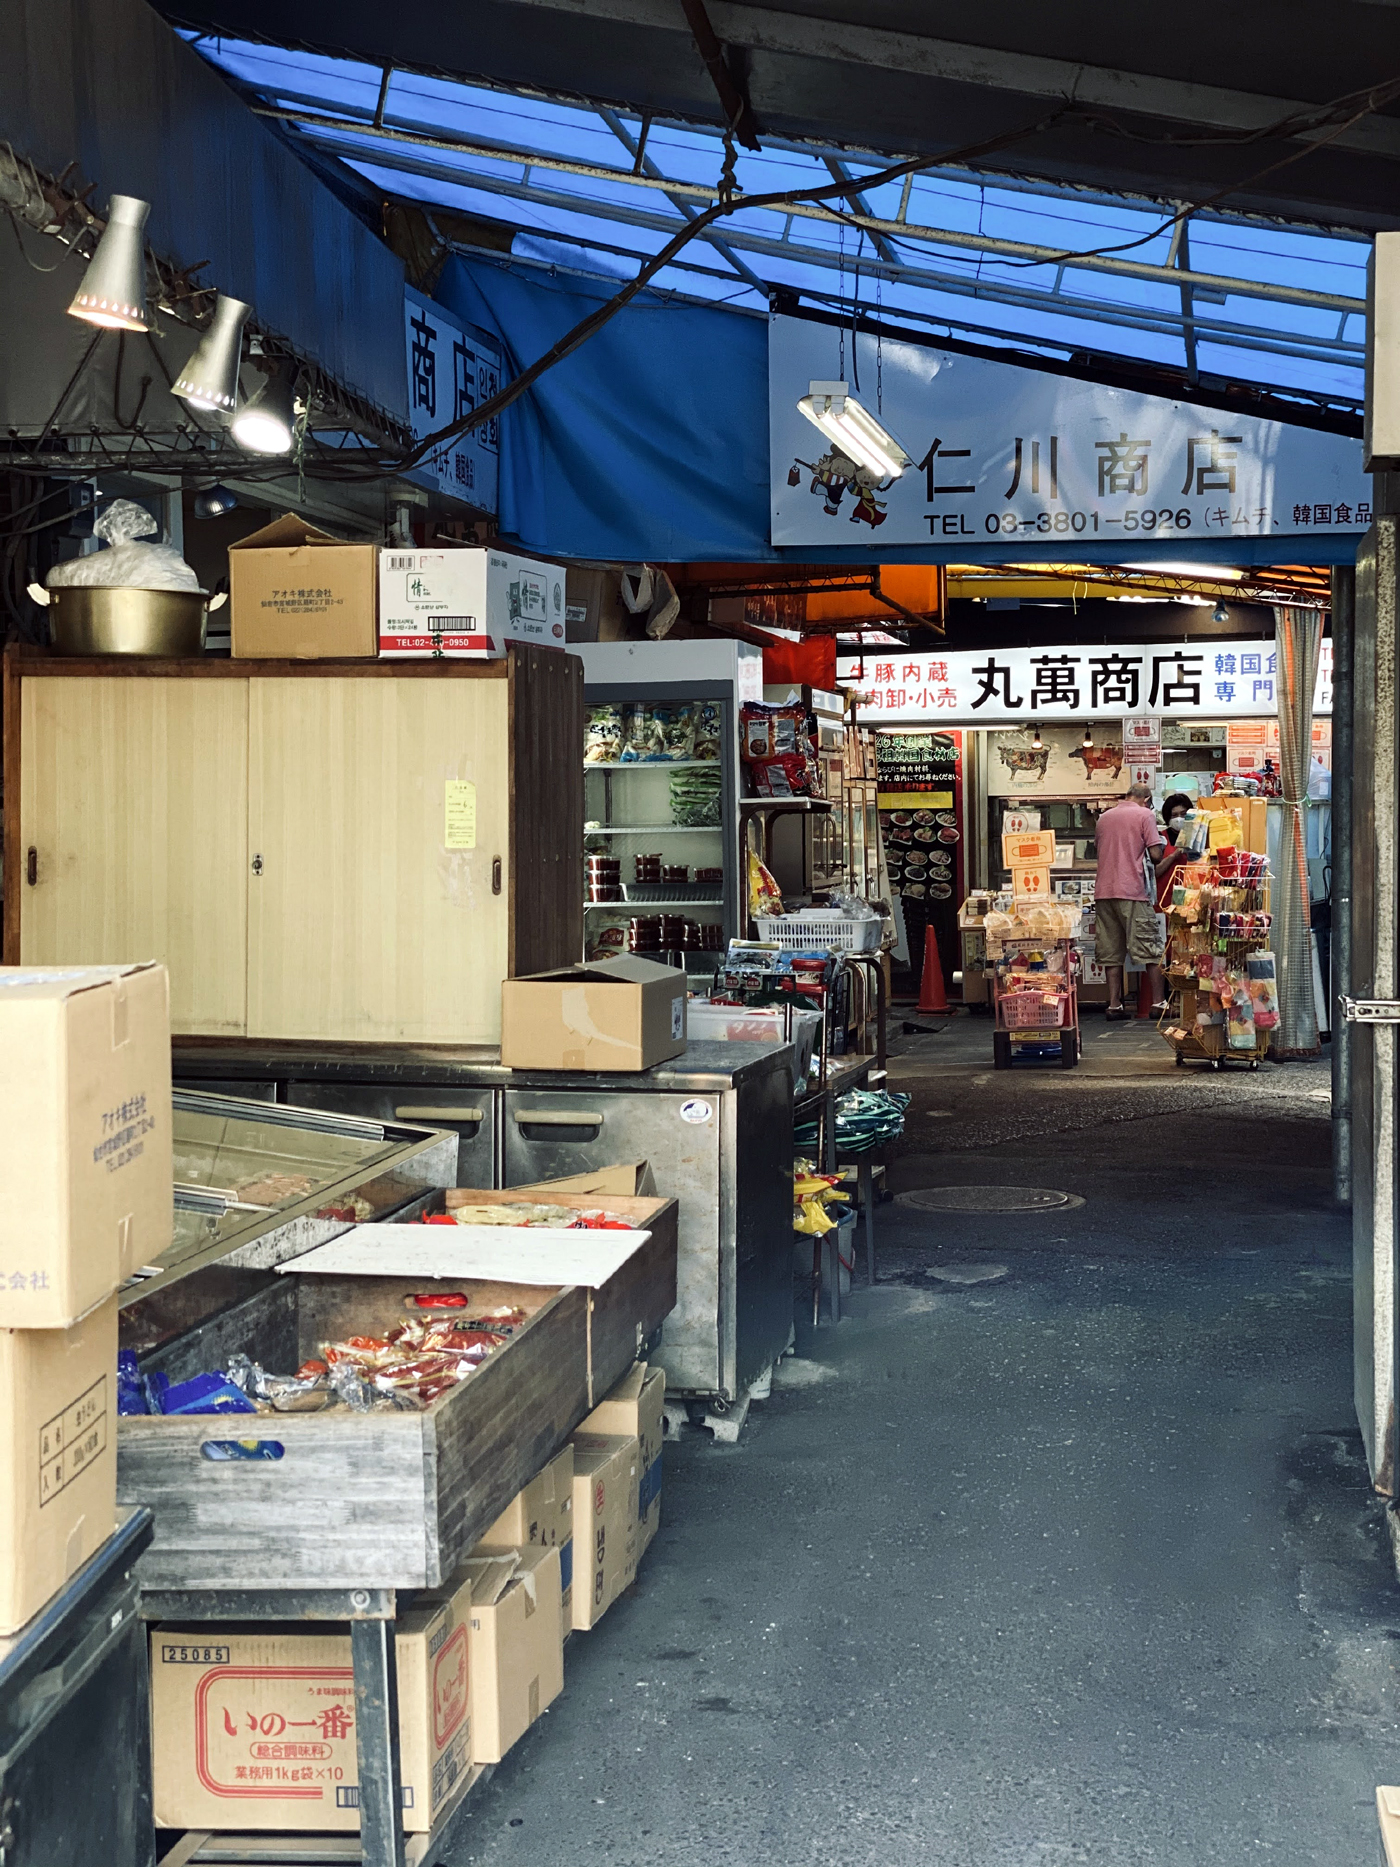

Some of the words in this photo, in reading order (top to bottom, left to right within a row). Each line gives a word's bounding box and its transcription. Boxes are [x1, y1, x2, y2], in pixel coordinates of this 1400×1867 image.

[920, 430, 1244, 503] 仁川商店
[924, 514, 976, 535] TEL
[970, 651, 1203, 709] 丸萬商店
[168, 1648, 223, 1661] 25085
[222, 1703, 354, 1740] いの一番
[256, 1744, 326, 1758] 総合調味料
